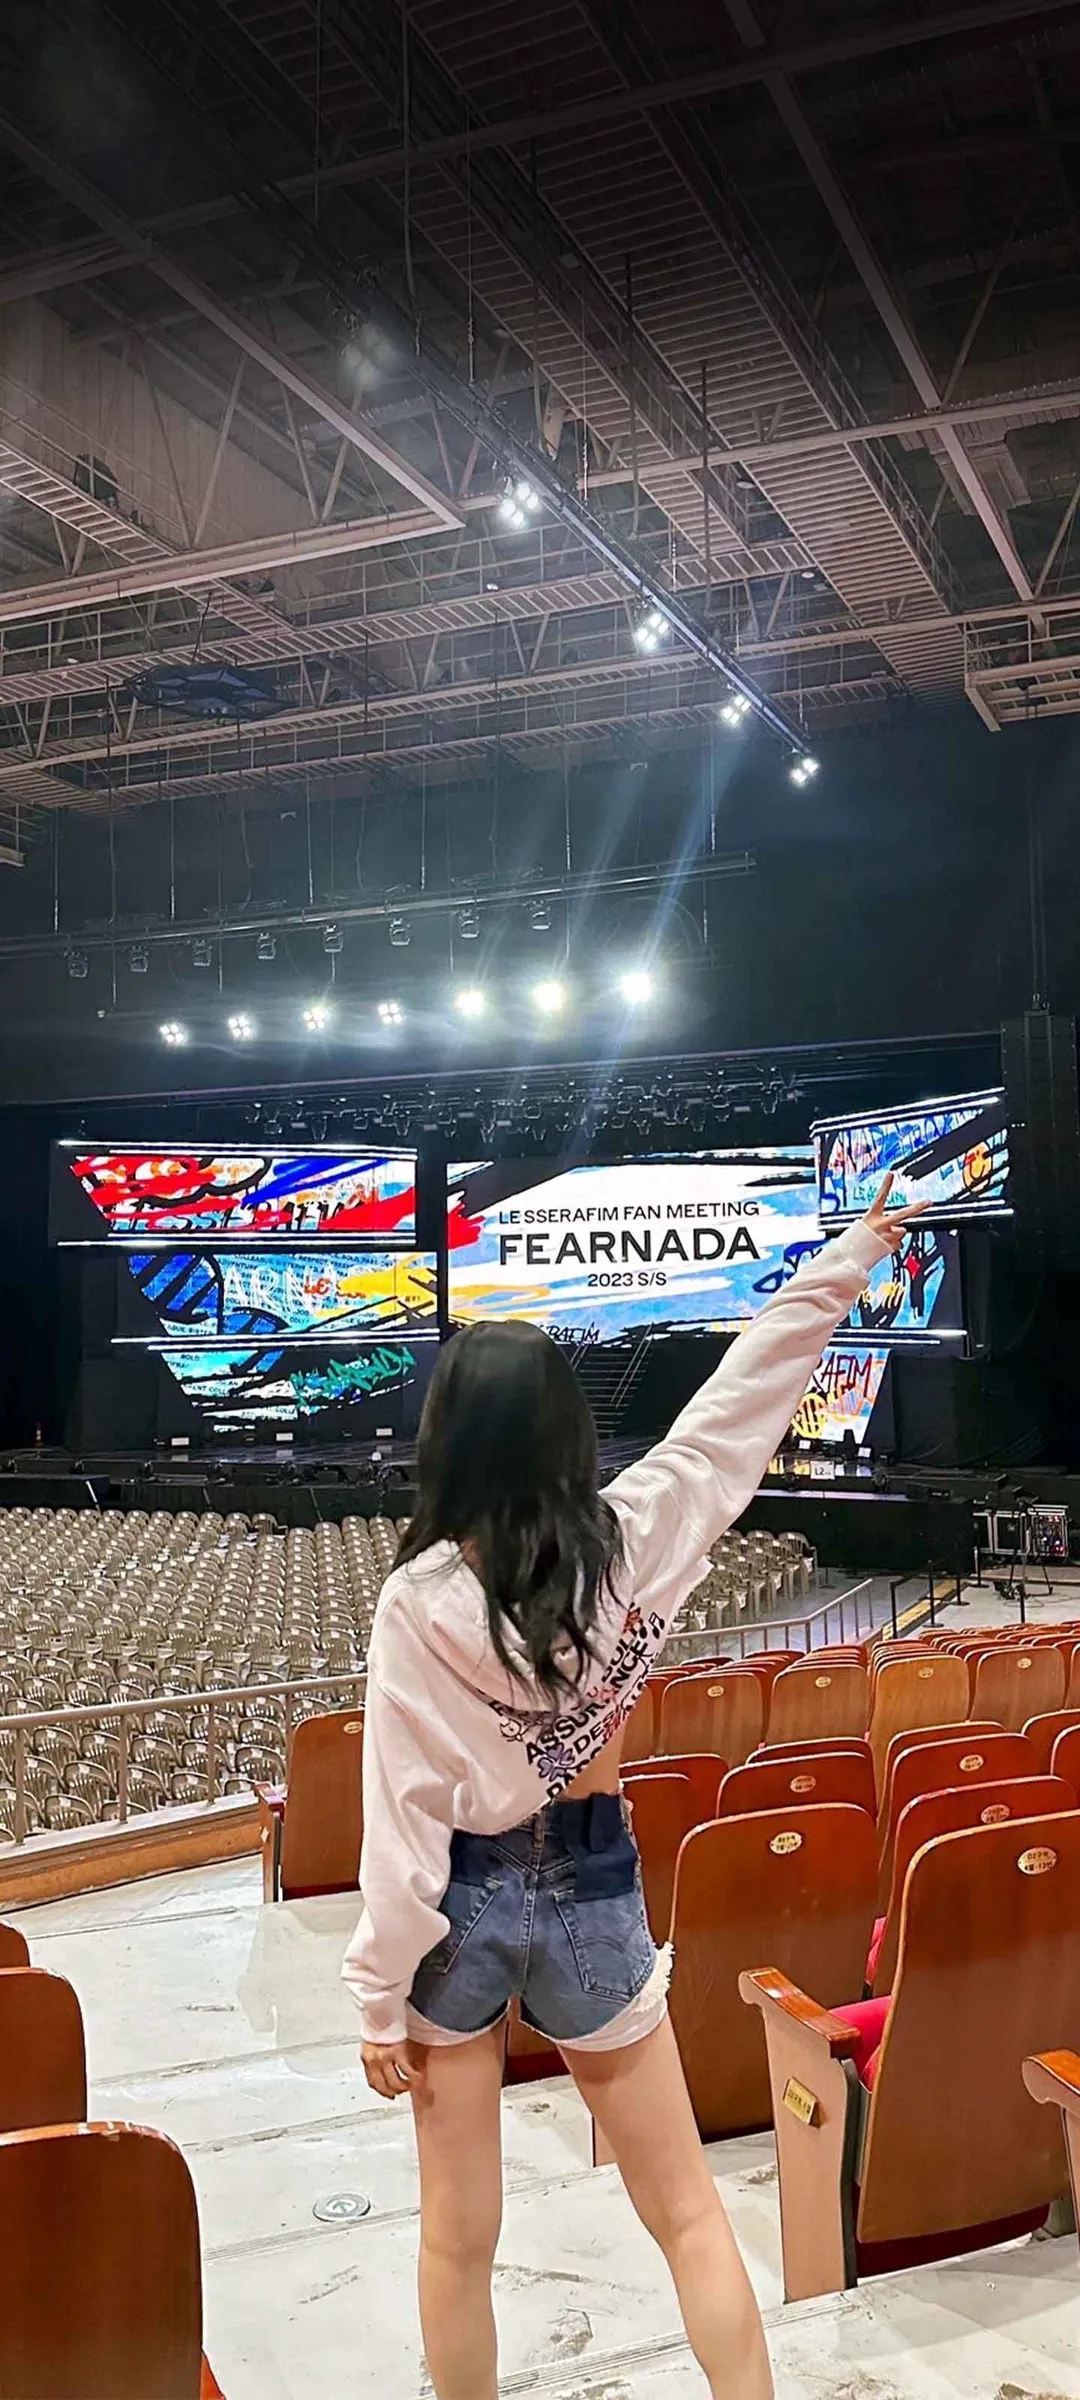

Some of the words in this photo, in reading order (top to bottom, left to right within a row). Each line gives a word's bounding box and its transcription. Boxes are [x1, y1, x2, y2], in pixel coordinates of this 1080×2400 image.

[499, 1210, 521, 1225] LE
[524, 1206, 619, 1224] SSERAFIM
[624, 1206, 662, 1221] FAN
[666, 1201, 760, 1219] MEETING
[499, 1226, 761, 1266] FEARNADA
[587, 1273, 634, 1288] 2023
[638, 1271, 668, 1287] S/S
